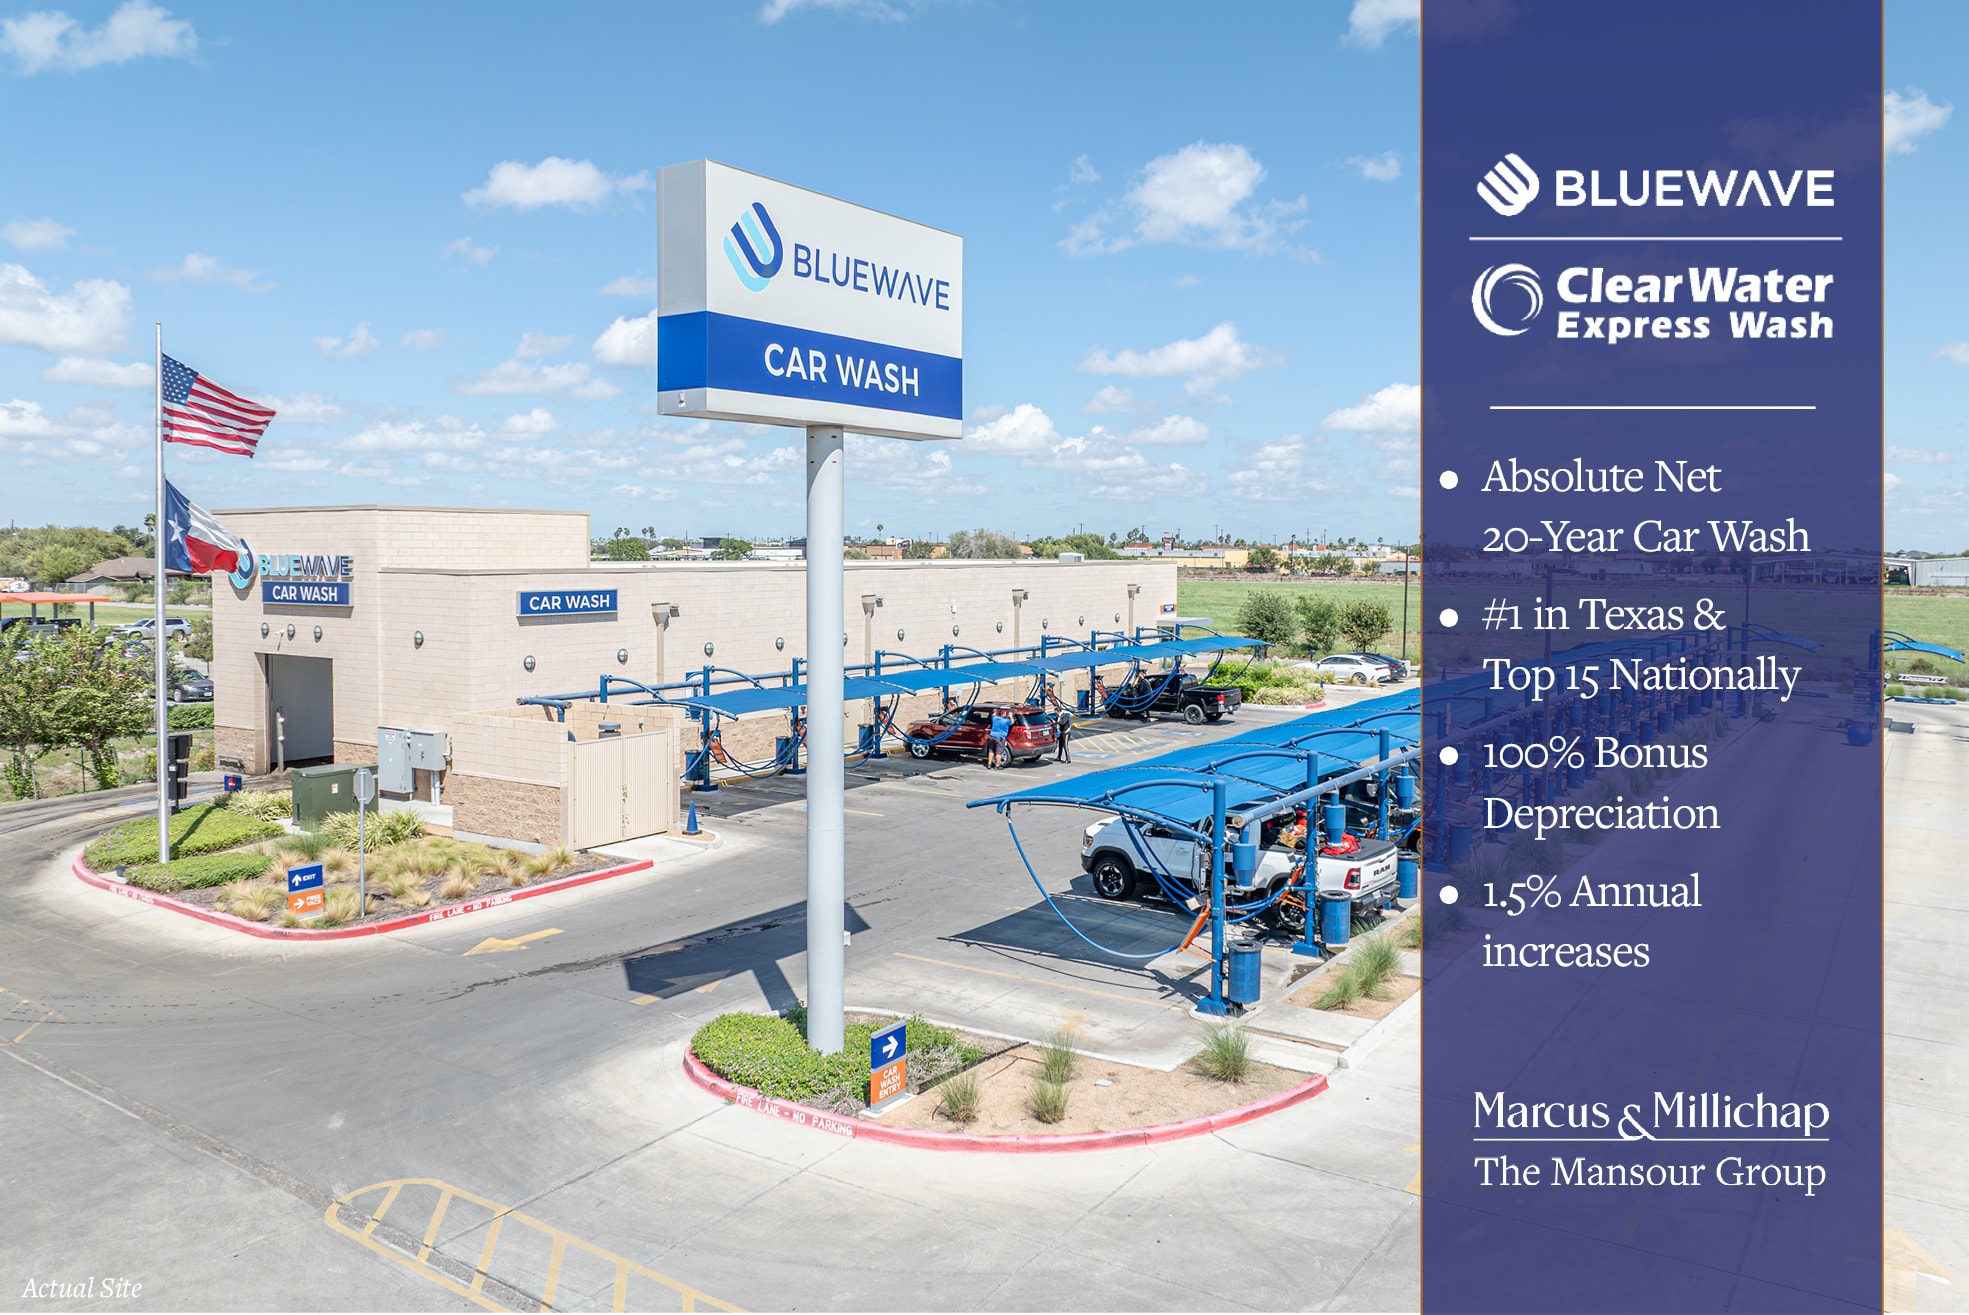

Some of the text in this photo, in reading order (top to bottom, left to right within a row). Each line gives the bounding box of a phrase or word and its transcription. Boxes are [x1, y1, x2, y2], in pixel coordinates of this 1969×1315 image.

[793, 243, 950, 311] BLUEWAVE
[764, 343, 919, 397] CAR WASH
[259, 555, 351, 577] BLUEWAVE
[272, 585, 338, 602] CAR WASH
[529, 594, 610, 610] CAR WASH
[303, 873, 316, 881] EXIT
[1373, 864, 1391, 876] RAM
[447, 905, 465, 917] LANE
[883, 1065, 898, 1079] CAR
[880, 1073, 900, 1089] WASH
[879, 1081, 902, 1099] ENTRY
[736, 1092, 753, 1107] FIRE
[757, 1100, 780, 1117] LANE
[792, 1110, 806, 1124] NO
[811, 1116, 853, 1136] PARKING
